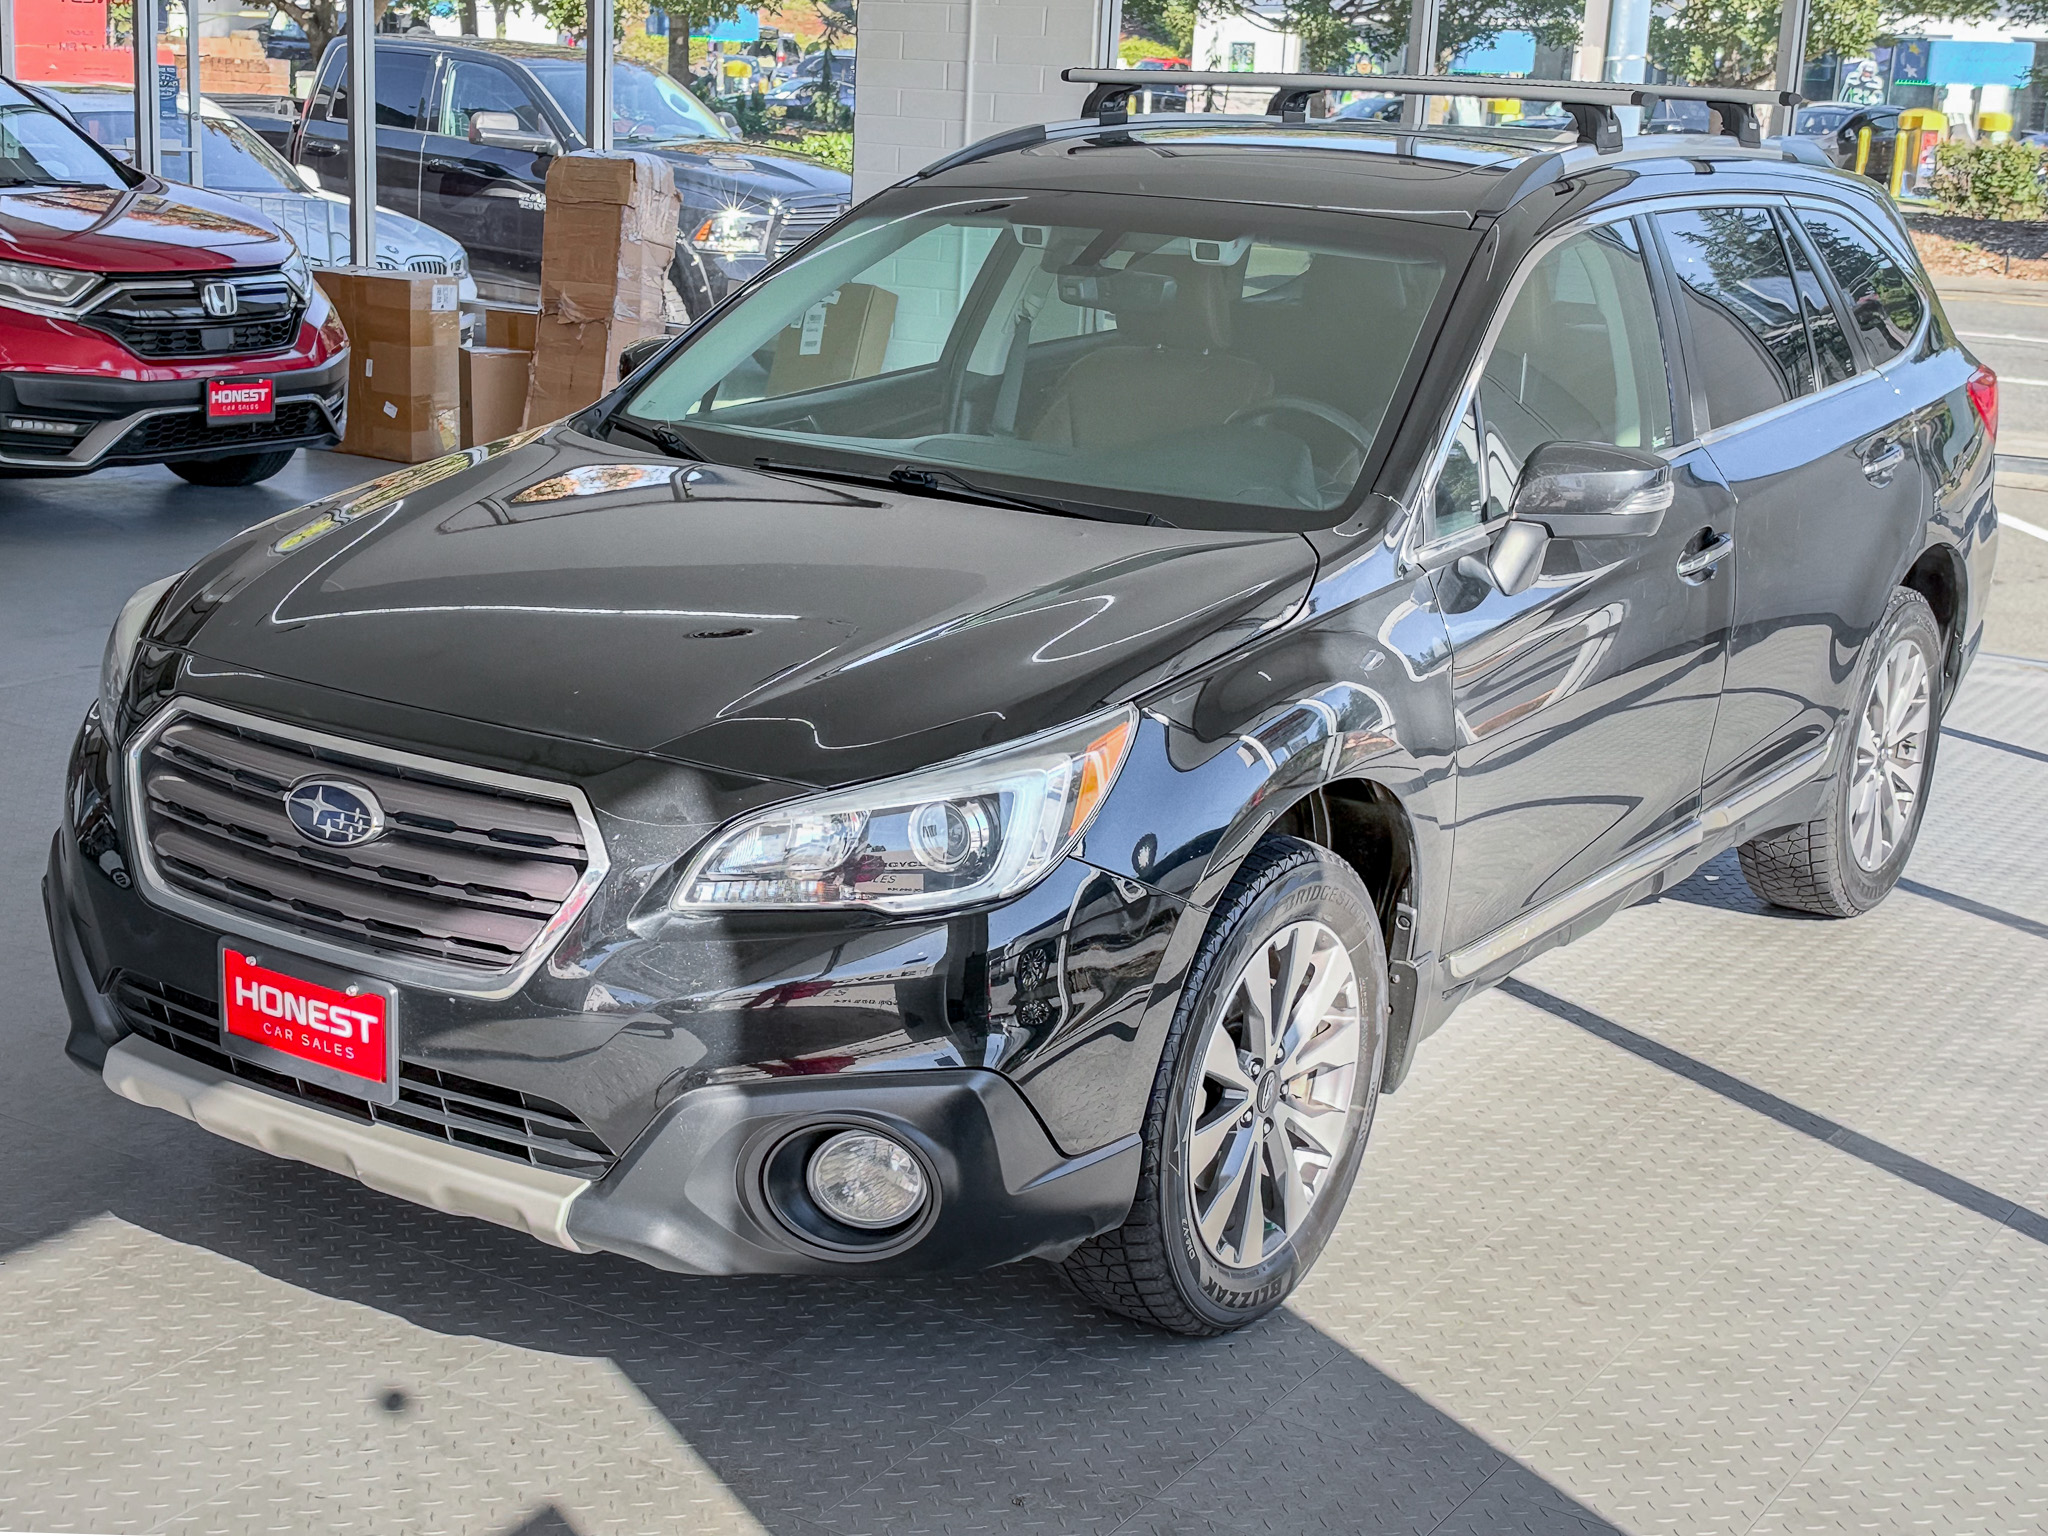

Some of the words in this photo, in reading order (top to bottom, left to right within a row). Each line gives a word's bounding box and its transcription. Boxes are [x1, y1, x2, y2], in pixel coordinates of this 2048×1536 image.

[211, 388, 270, 404] HONEST
[222, 404, 236, 412] CAR
[238, 403, 259, 411] SALES
[235, 976, 378, 1043] HONEST
[263, 1022, 293, 1041] CAR
[301, 1034, 354, 1059] SALES
[1202, 1276, 1282, 1309] BLIZZAK
